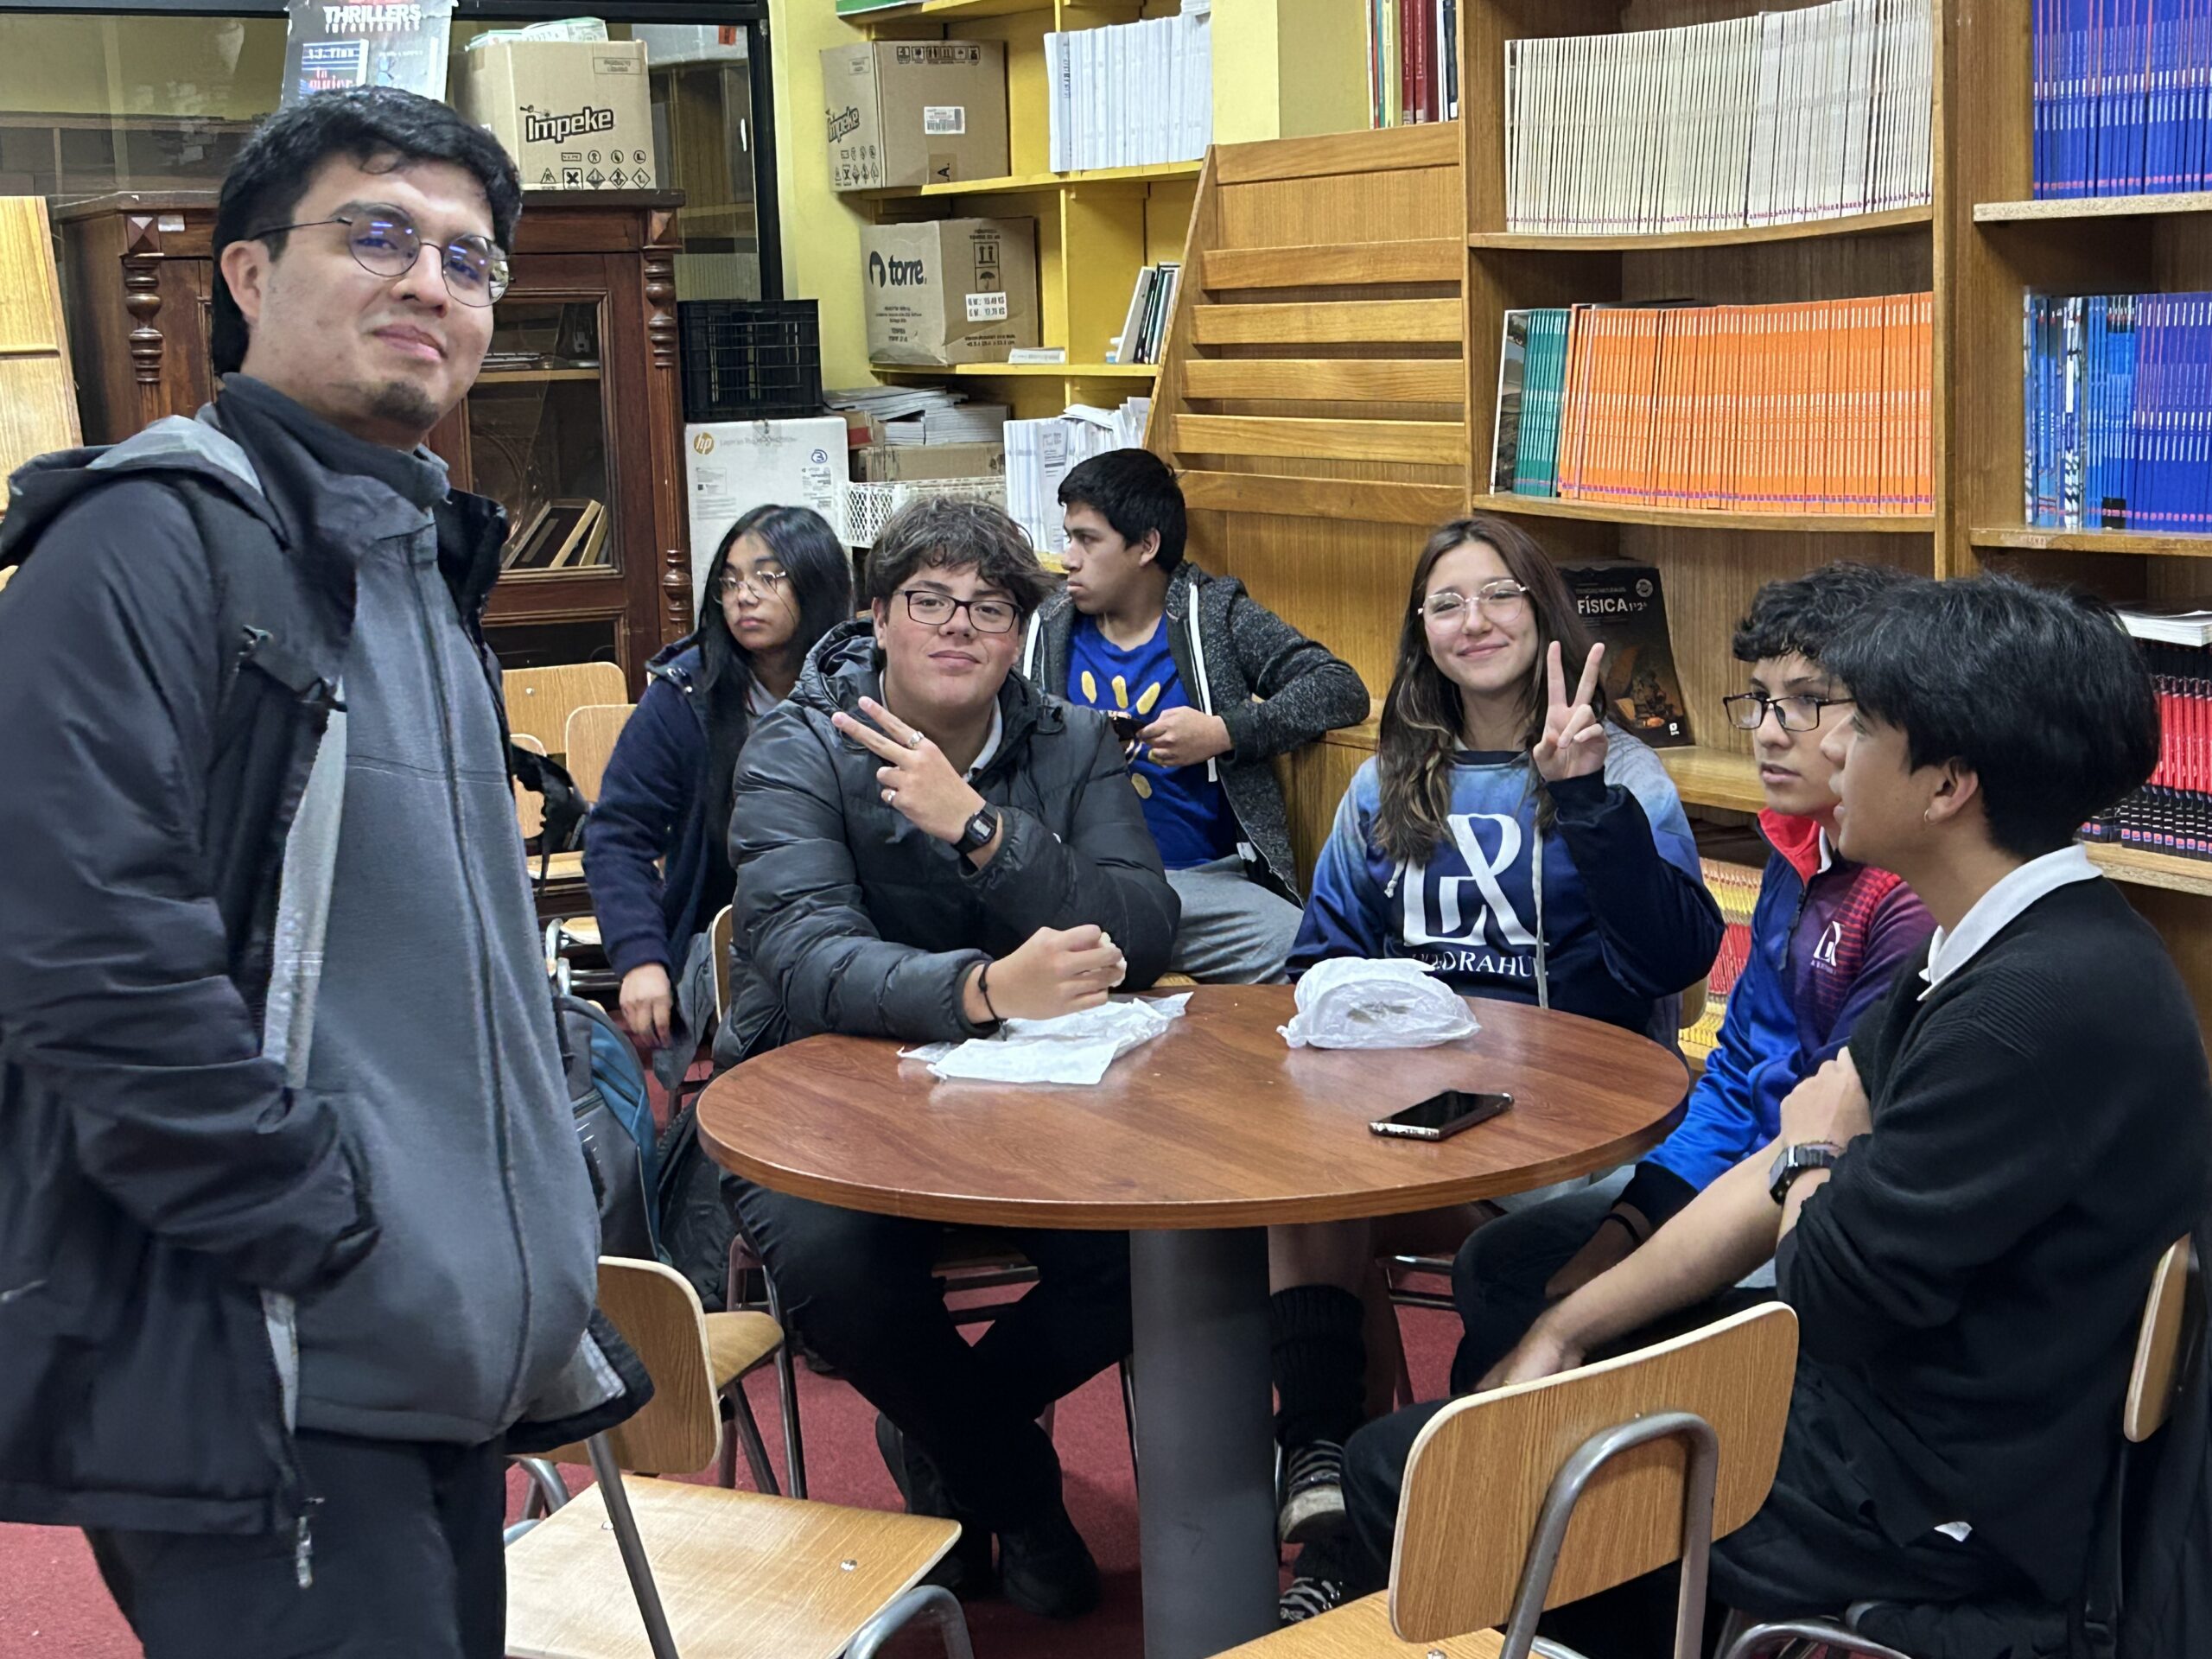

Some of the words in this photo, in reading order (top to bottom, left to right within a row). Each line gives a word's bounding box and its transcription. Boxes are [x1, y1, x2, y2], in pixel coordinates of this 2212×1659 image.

[323, 4, 422, 23] THRILLERS
[526, 106, 614, 143] Impeke
[695, 433, 713, 454] hp
[1577, 596, 1628, 614] FÍSICA
